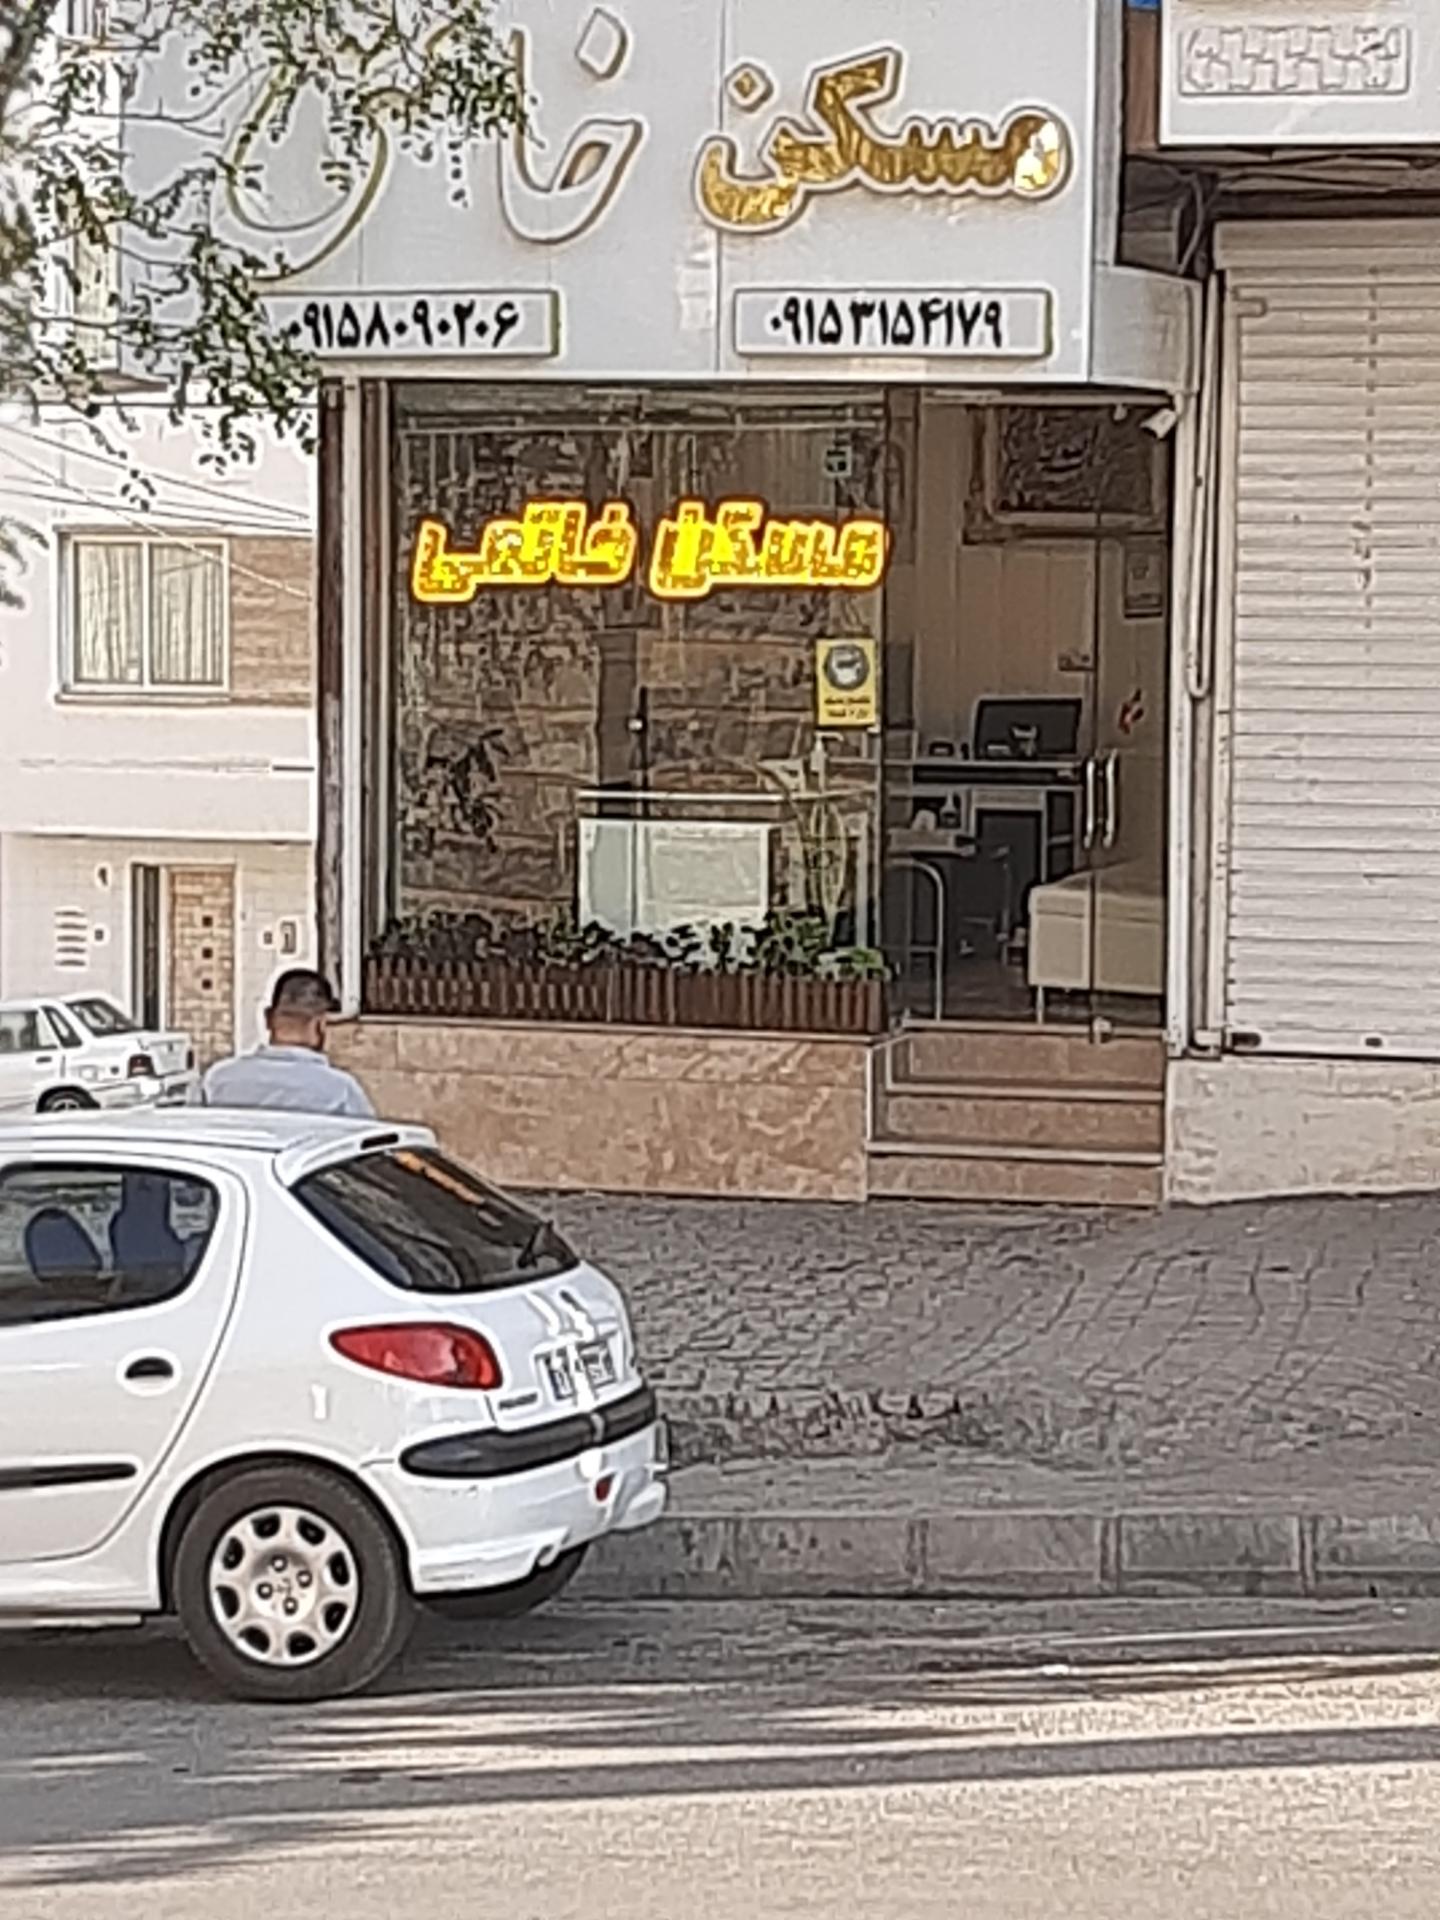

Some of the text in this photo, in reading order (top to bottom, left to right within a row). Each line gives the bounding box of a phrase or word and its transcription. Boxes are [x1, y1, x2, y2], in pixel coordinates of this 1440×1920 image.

[696, 46, 1074, 232] مسکن
[288, 299, 519, 349] ۰۹۱۵۸۰۹۰۲۰۶
[771, 296, 1002, 348] ۰۹۱۵۳۱۵۴۱۷۹
[650, 502, 887, 597] مسکن
